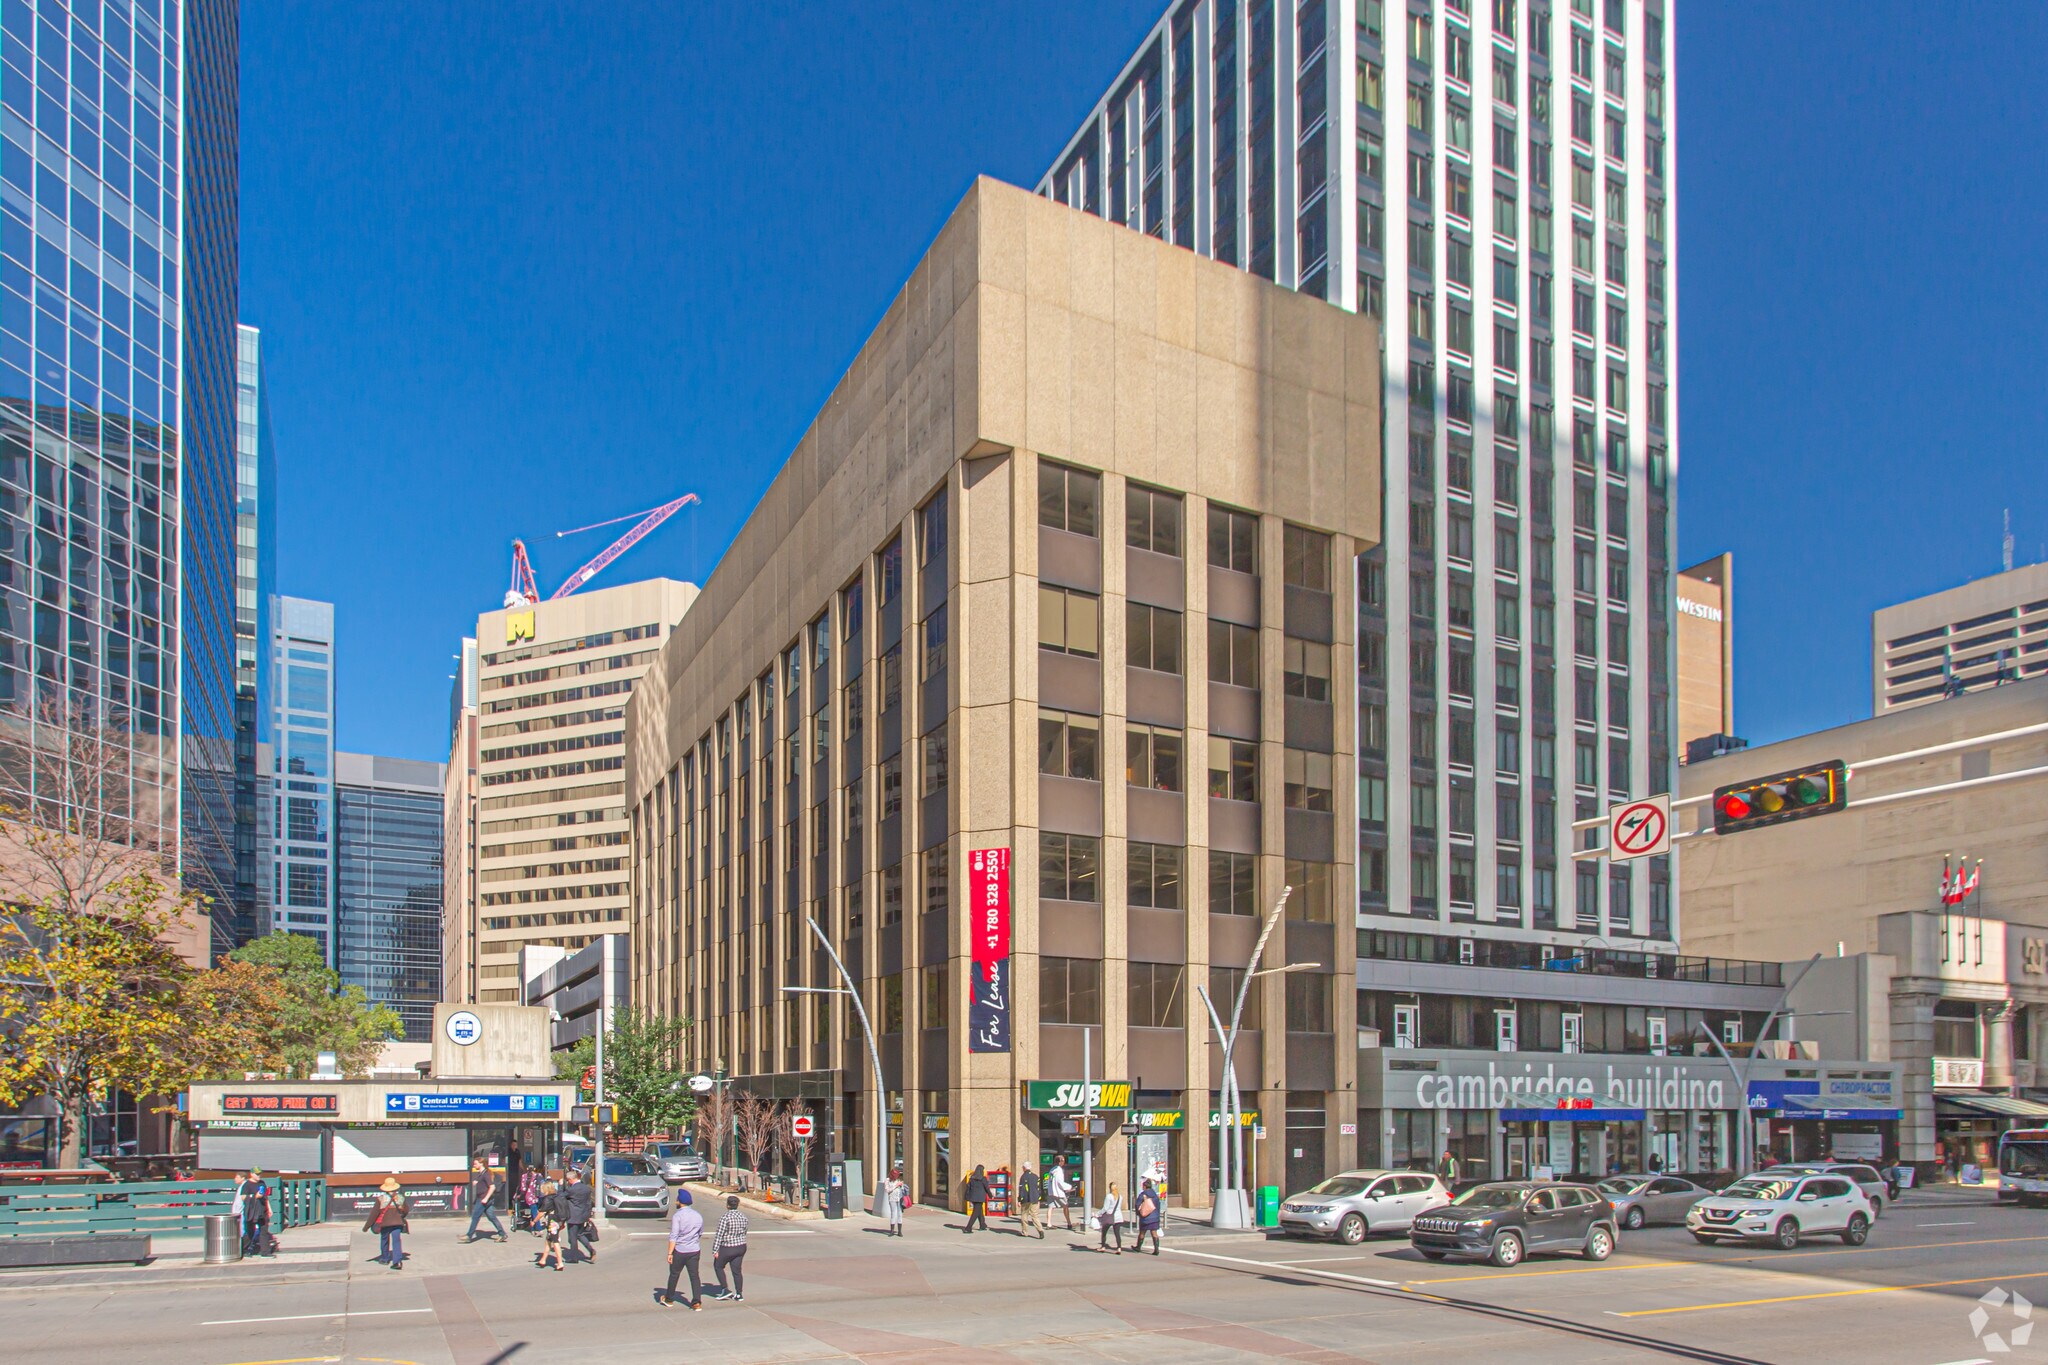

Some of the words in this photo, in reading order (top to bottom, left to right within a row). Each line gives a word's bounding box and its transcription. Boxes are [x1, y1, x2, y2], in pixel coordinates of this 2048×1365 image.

[1676, 595, 1722, 622] WESTIN
[986, 850, 999, 881] 2550
[986, 883, 999, 906] 328
[986, 909, 999, 932] 780
[986, 934, 999, 949] +1
[981, 961, 1005, 1010] Lease
[980, 1014, 1003, 1047] For
[1047, 1083, 1132, 1108] SUBWAY
[1416, 1061, 1595, 1108] cambridge
[1607, 1065, 1723, 1108] building
[1830, 1082, 1892, 1094] CHIROPRACTOR
[224, 1097, 248, 1109] GET
[251, 1097, 279, 1109] YOUR
[282, 1097, 307, 1109] FINK
[310, 1097, 327, 1109] ON
[1746, 1093, 1768, 1107] Lofts
[259, 1120, 301, 1128] CANTEEN
[923, 1115, 949, 1129] SUBWA
